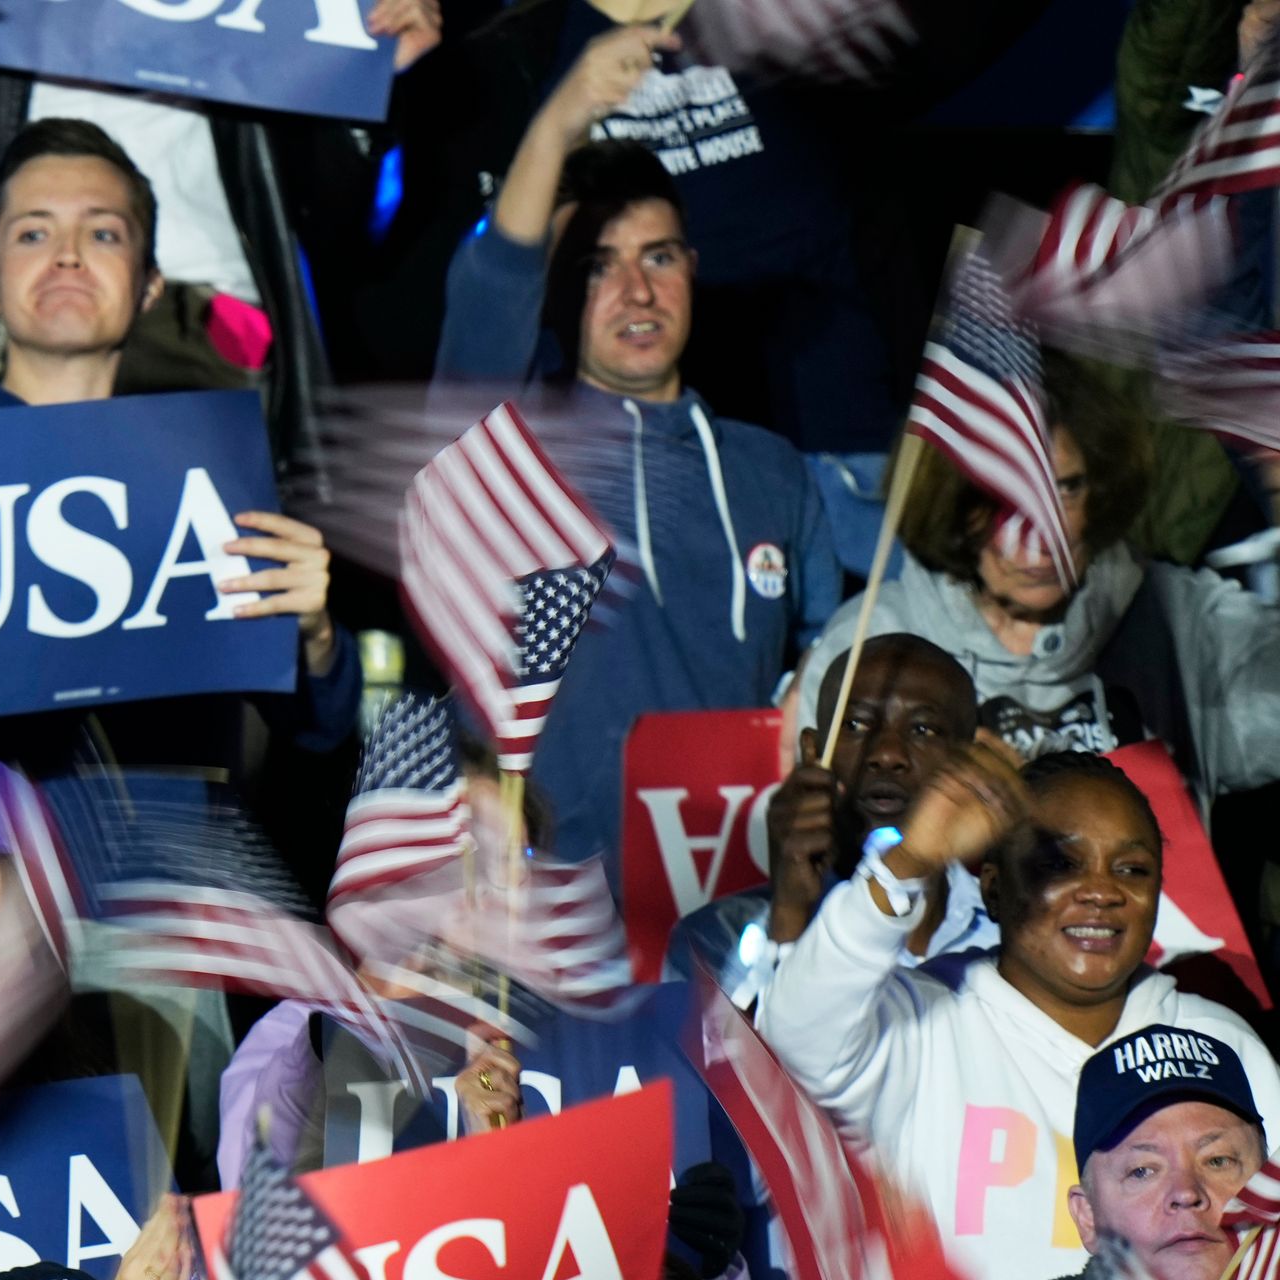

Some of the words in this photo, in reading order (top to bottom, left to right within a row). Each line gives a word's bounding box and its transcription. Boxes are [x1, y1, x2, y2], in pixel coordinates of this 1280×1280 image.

[696, 125, 764, 166] HOUSE
[1113, 1032, 1219, 1075] HARRIS
[1136, 1060, 1213, 1083] WALZ
